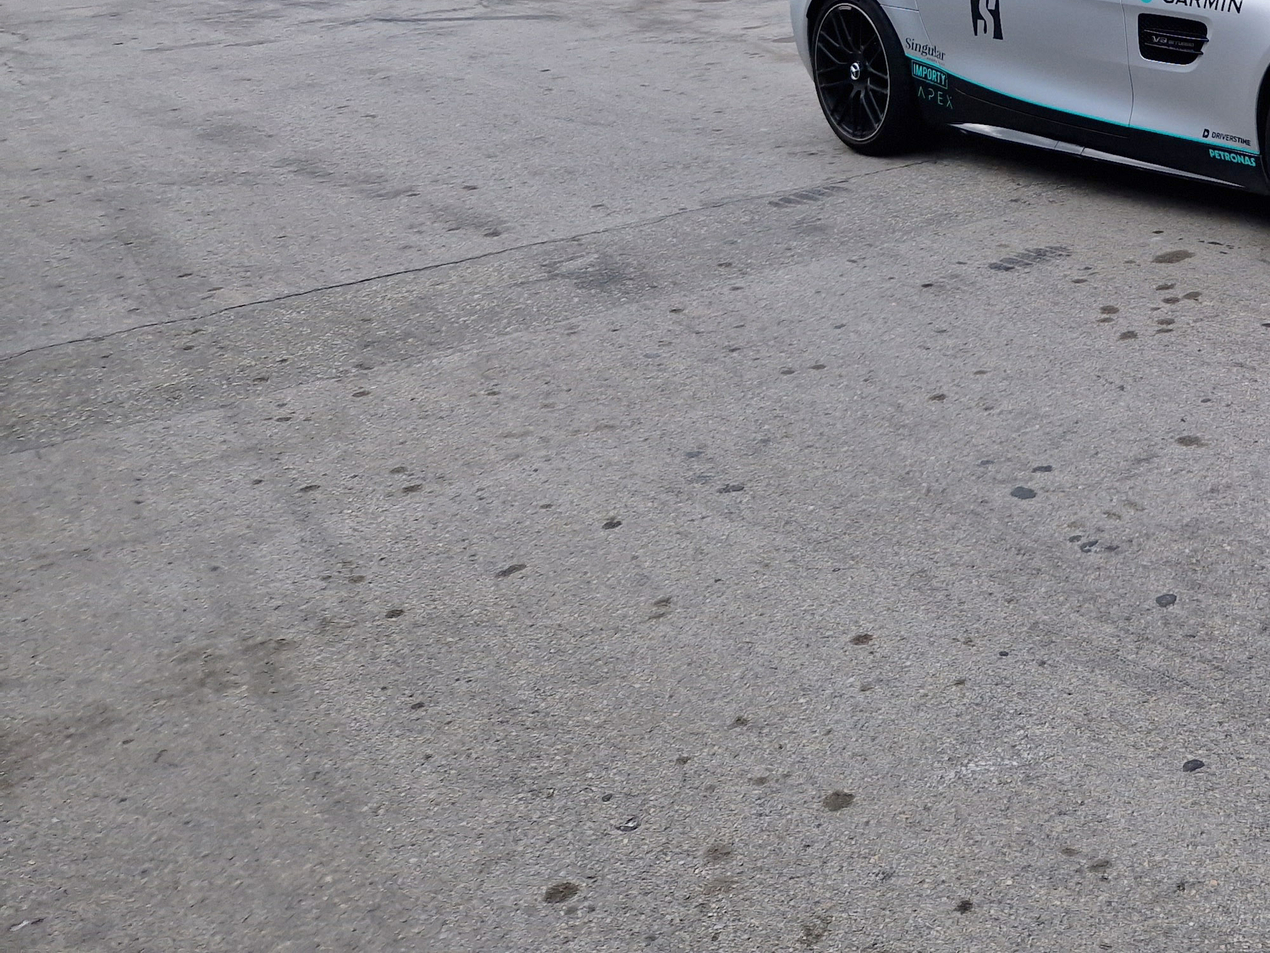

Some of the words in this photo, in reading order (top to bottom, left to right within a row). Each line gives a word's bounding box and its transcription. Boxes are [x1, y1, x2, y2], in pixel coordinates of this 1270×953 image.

[905, 37, 946, 61] Singular
[913, 63, 946, 85] IMPORTY
[1208, 148, 1257, 167] PETRONAS
